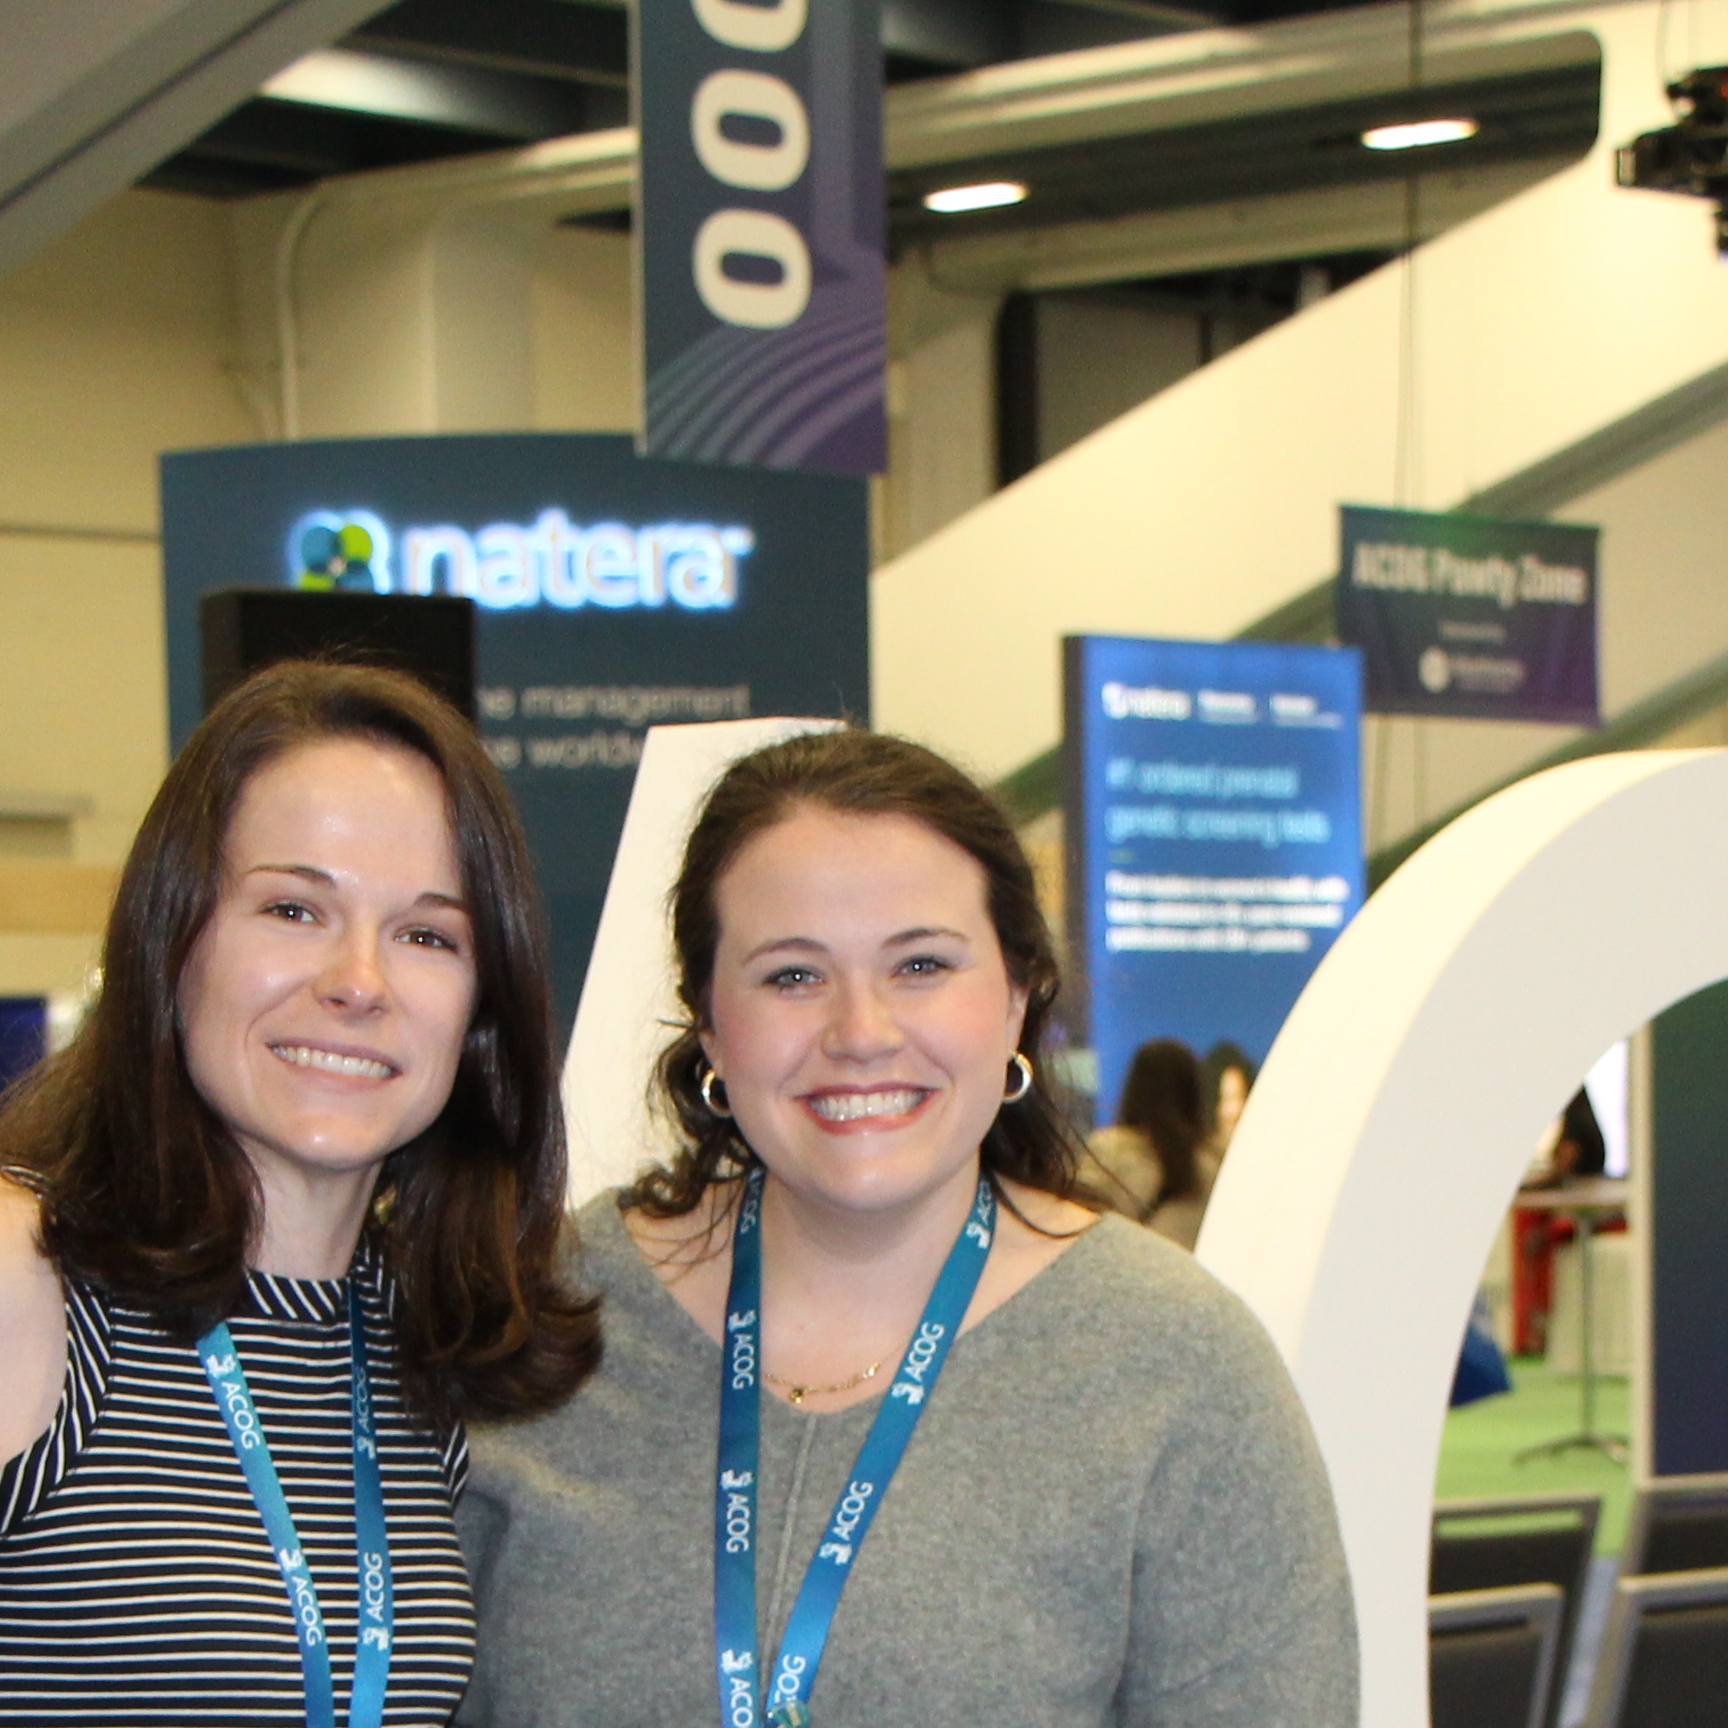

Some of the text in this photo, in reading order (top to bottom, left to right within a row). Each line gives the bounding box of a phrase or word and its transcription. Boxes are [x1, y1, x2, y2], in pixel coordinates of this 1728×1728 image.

[731, 1333, 755, 1391] ACOG
[903, 1321, 946, 1382] ACOG
[221, 1381, 261, 1450] ACOG
[726, 1492, 751, 1554] ACOG
[832, 1480, 874, 1541] ACOG
[291, 1575, 322, 1647] ACOG
[364, 1552, 384, 1622] ACOG
